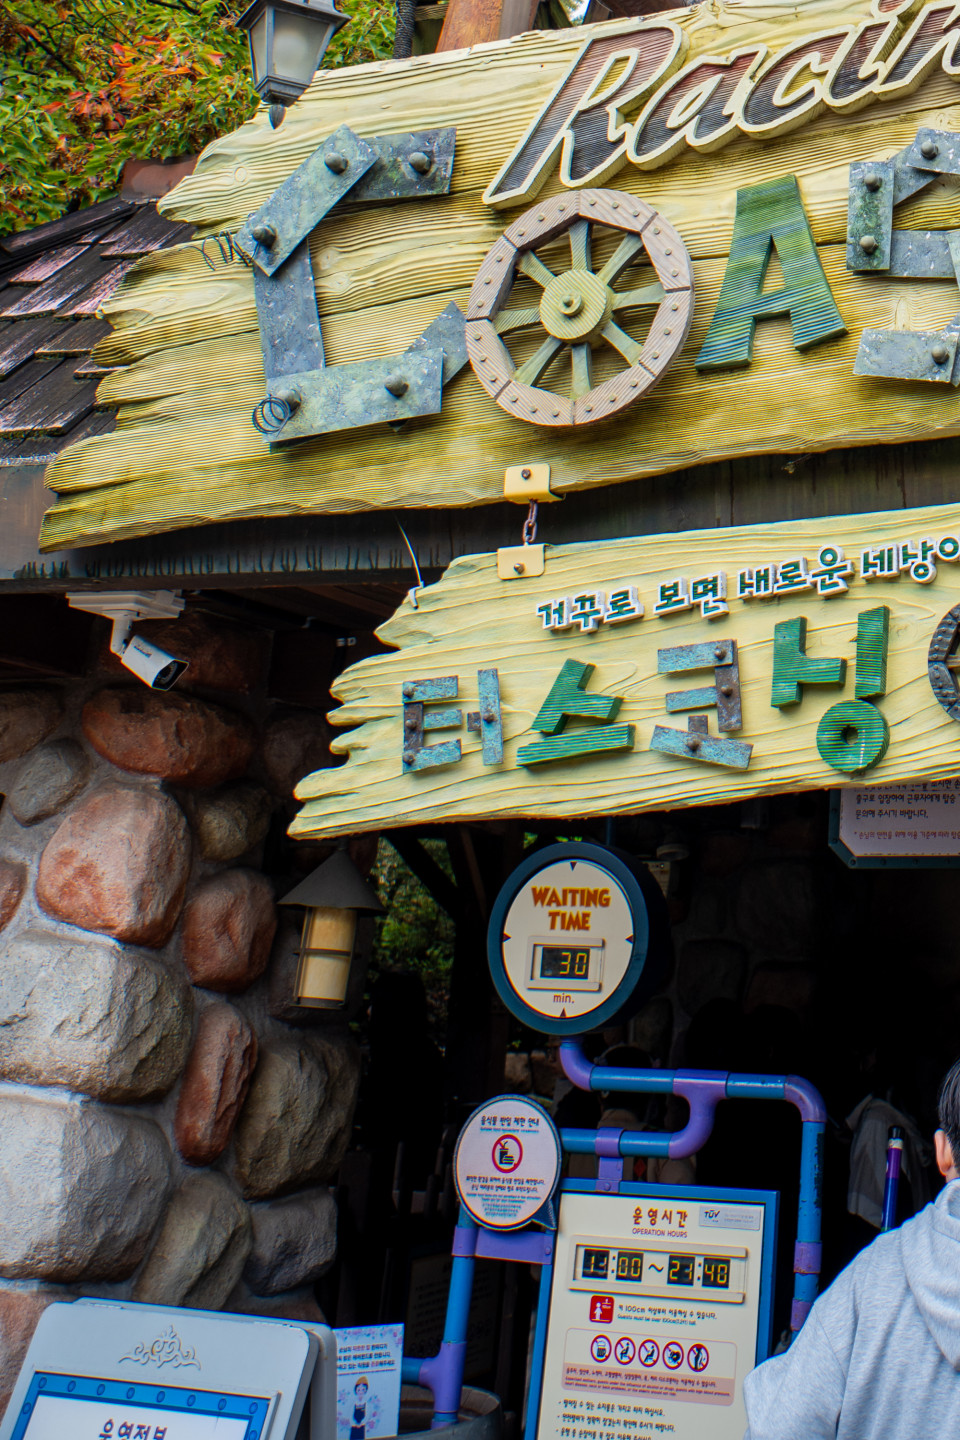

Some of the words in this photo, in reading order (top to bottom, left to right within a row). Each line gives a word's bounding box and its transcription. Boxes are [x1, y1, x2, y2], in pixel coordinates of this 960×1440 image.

[536, 586, 645, 634] 거꾸로
[653, 570, 729, 618] 보면
[737, 544, 855, 601] 새로운
[877, 793, 905, 805] 입장하여
[942, 793, 956, 804] 탑승
[877, 808, 898, 818] 주시기
[899, 808, 929, 820] 바랍니다.
[531, 886, 611, 908] WAITING
[548, 910, 591, 931] TIME
[559, 951, 587, 975] 30
[553, 992, 575, 1004] min.
[632, 1205, 688, 1228] 운영시간
[631, 1227, 666, 1237] OPERATION
[667, 1230, 688, 1239] HOURS
[625, 1305, 646, 1313] 100cm
